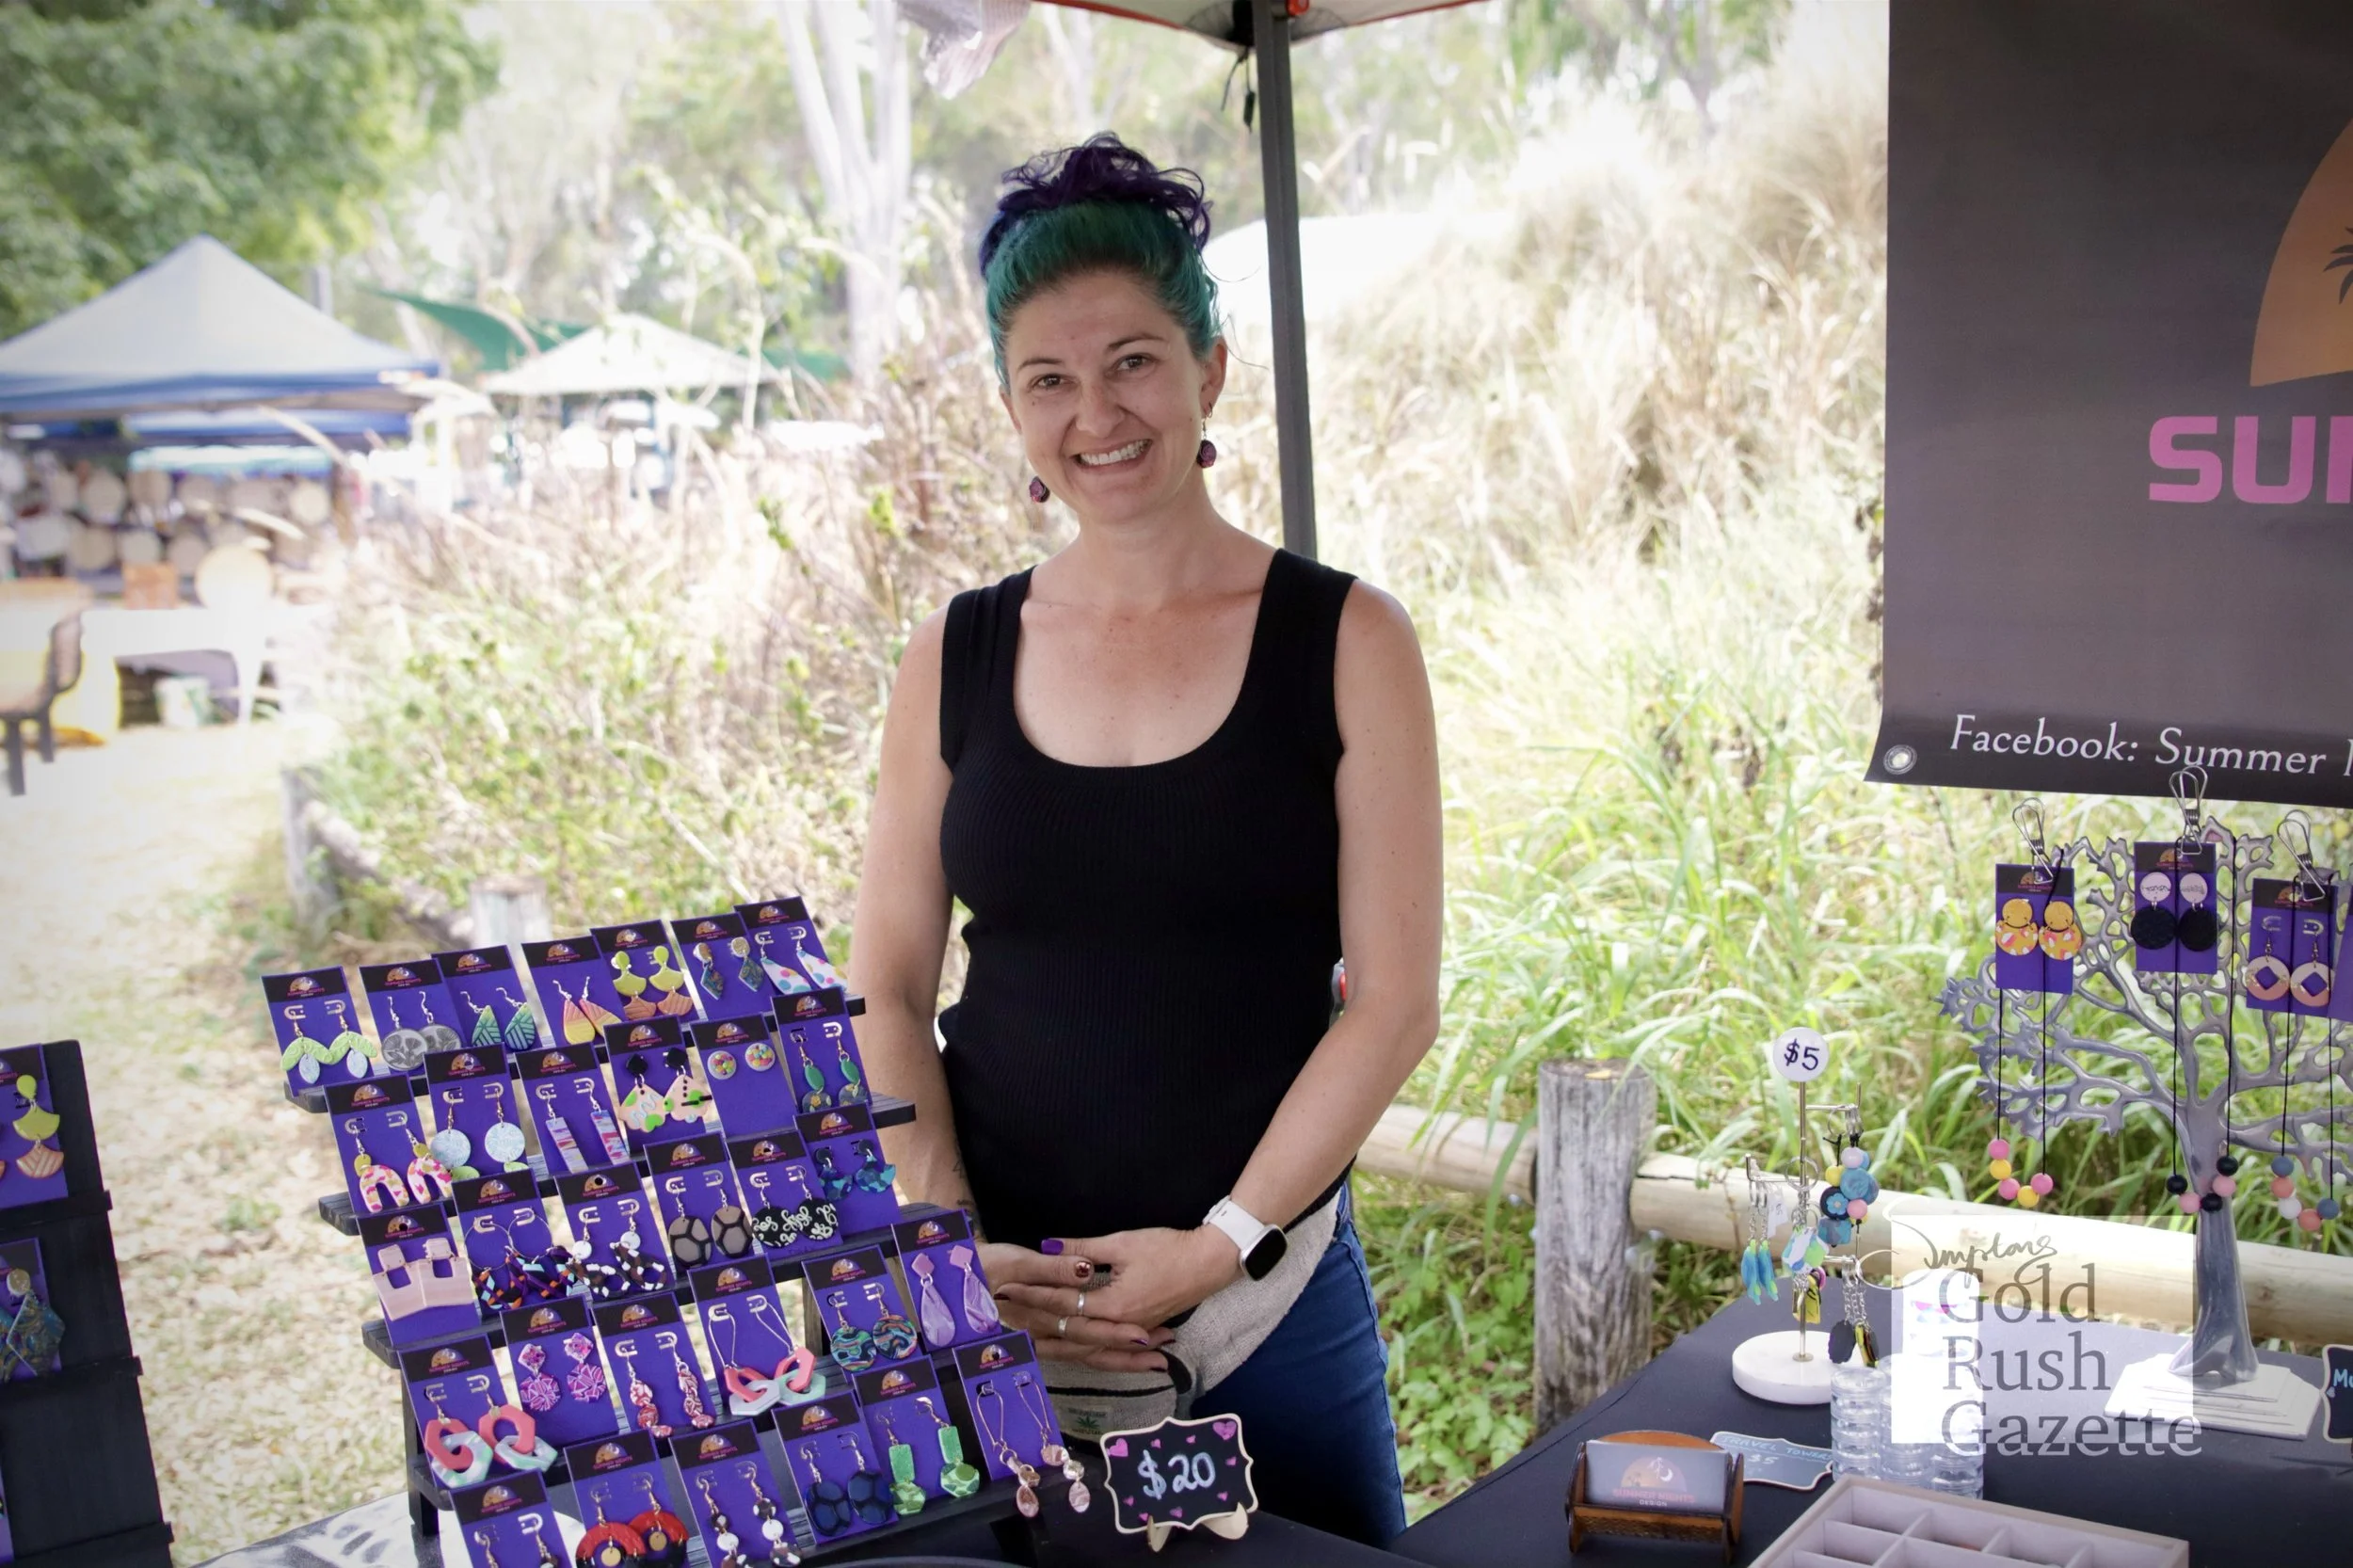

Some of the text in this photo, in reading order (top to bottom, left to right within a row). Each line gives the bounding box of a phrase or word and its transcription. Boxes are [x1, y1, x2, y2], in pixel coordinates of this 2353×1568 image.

[1950, 714, 2137, 761] Facebook:
[2155, 728, 2327, 775] Summer
[1785, 1038, 1819, 1071] $5
[1723, 1436, 1776, 1450] TRAVEL
[1138, 1449, 1215, 1500] $20
